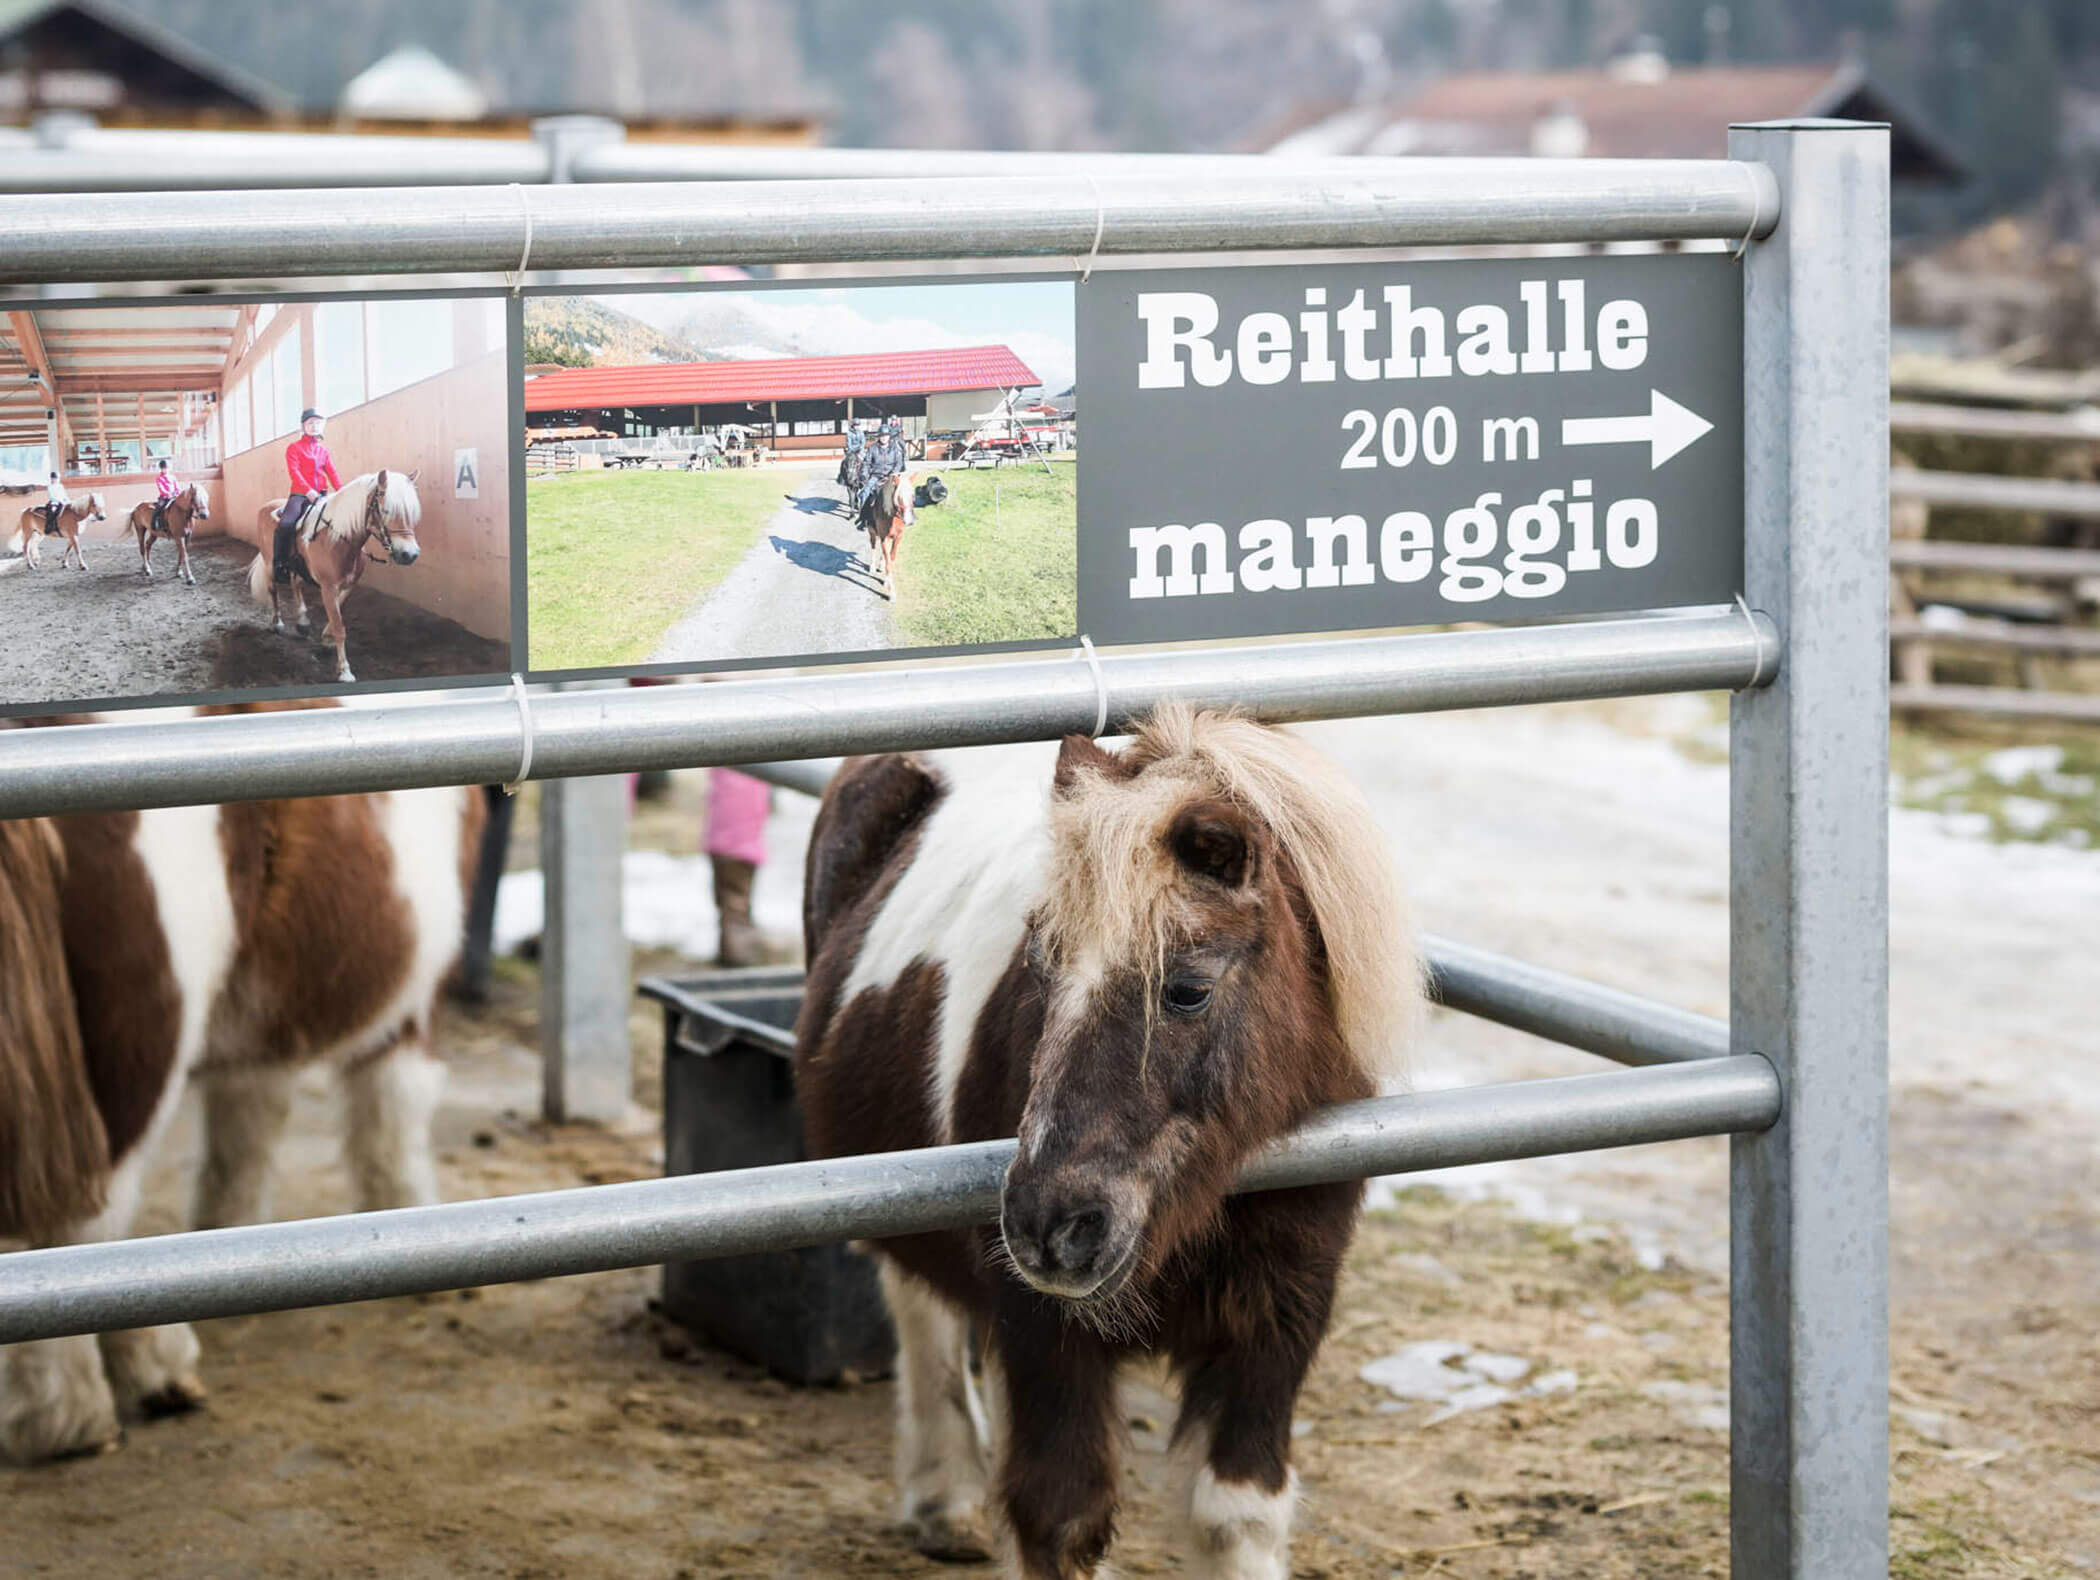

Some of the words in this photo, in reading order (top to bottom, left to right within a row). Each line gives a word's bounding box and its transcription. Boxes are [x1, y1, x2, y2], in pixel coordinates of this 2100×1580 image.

[1137, 279, 1649, 390] Reithalle
[456, 459, 477, 489] A
[1340, 405, 1458, 470] 200
[1482, 416, 1540, 463] m
[1128, 478, 1658, 603] maneggio
